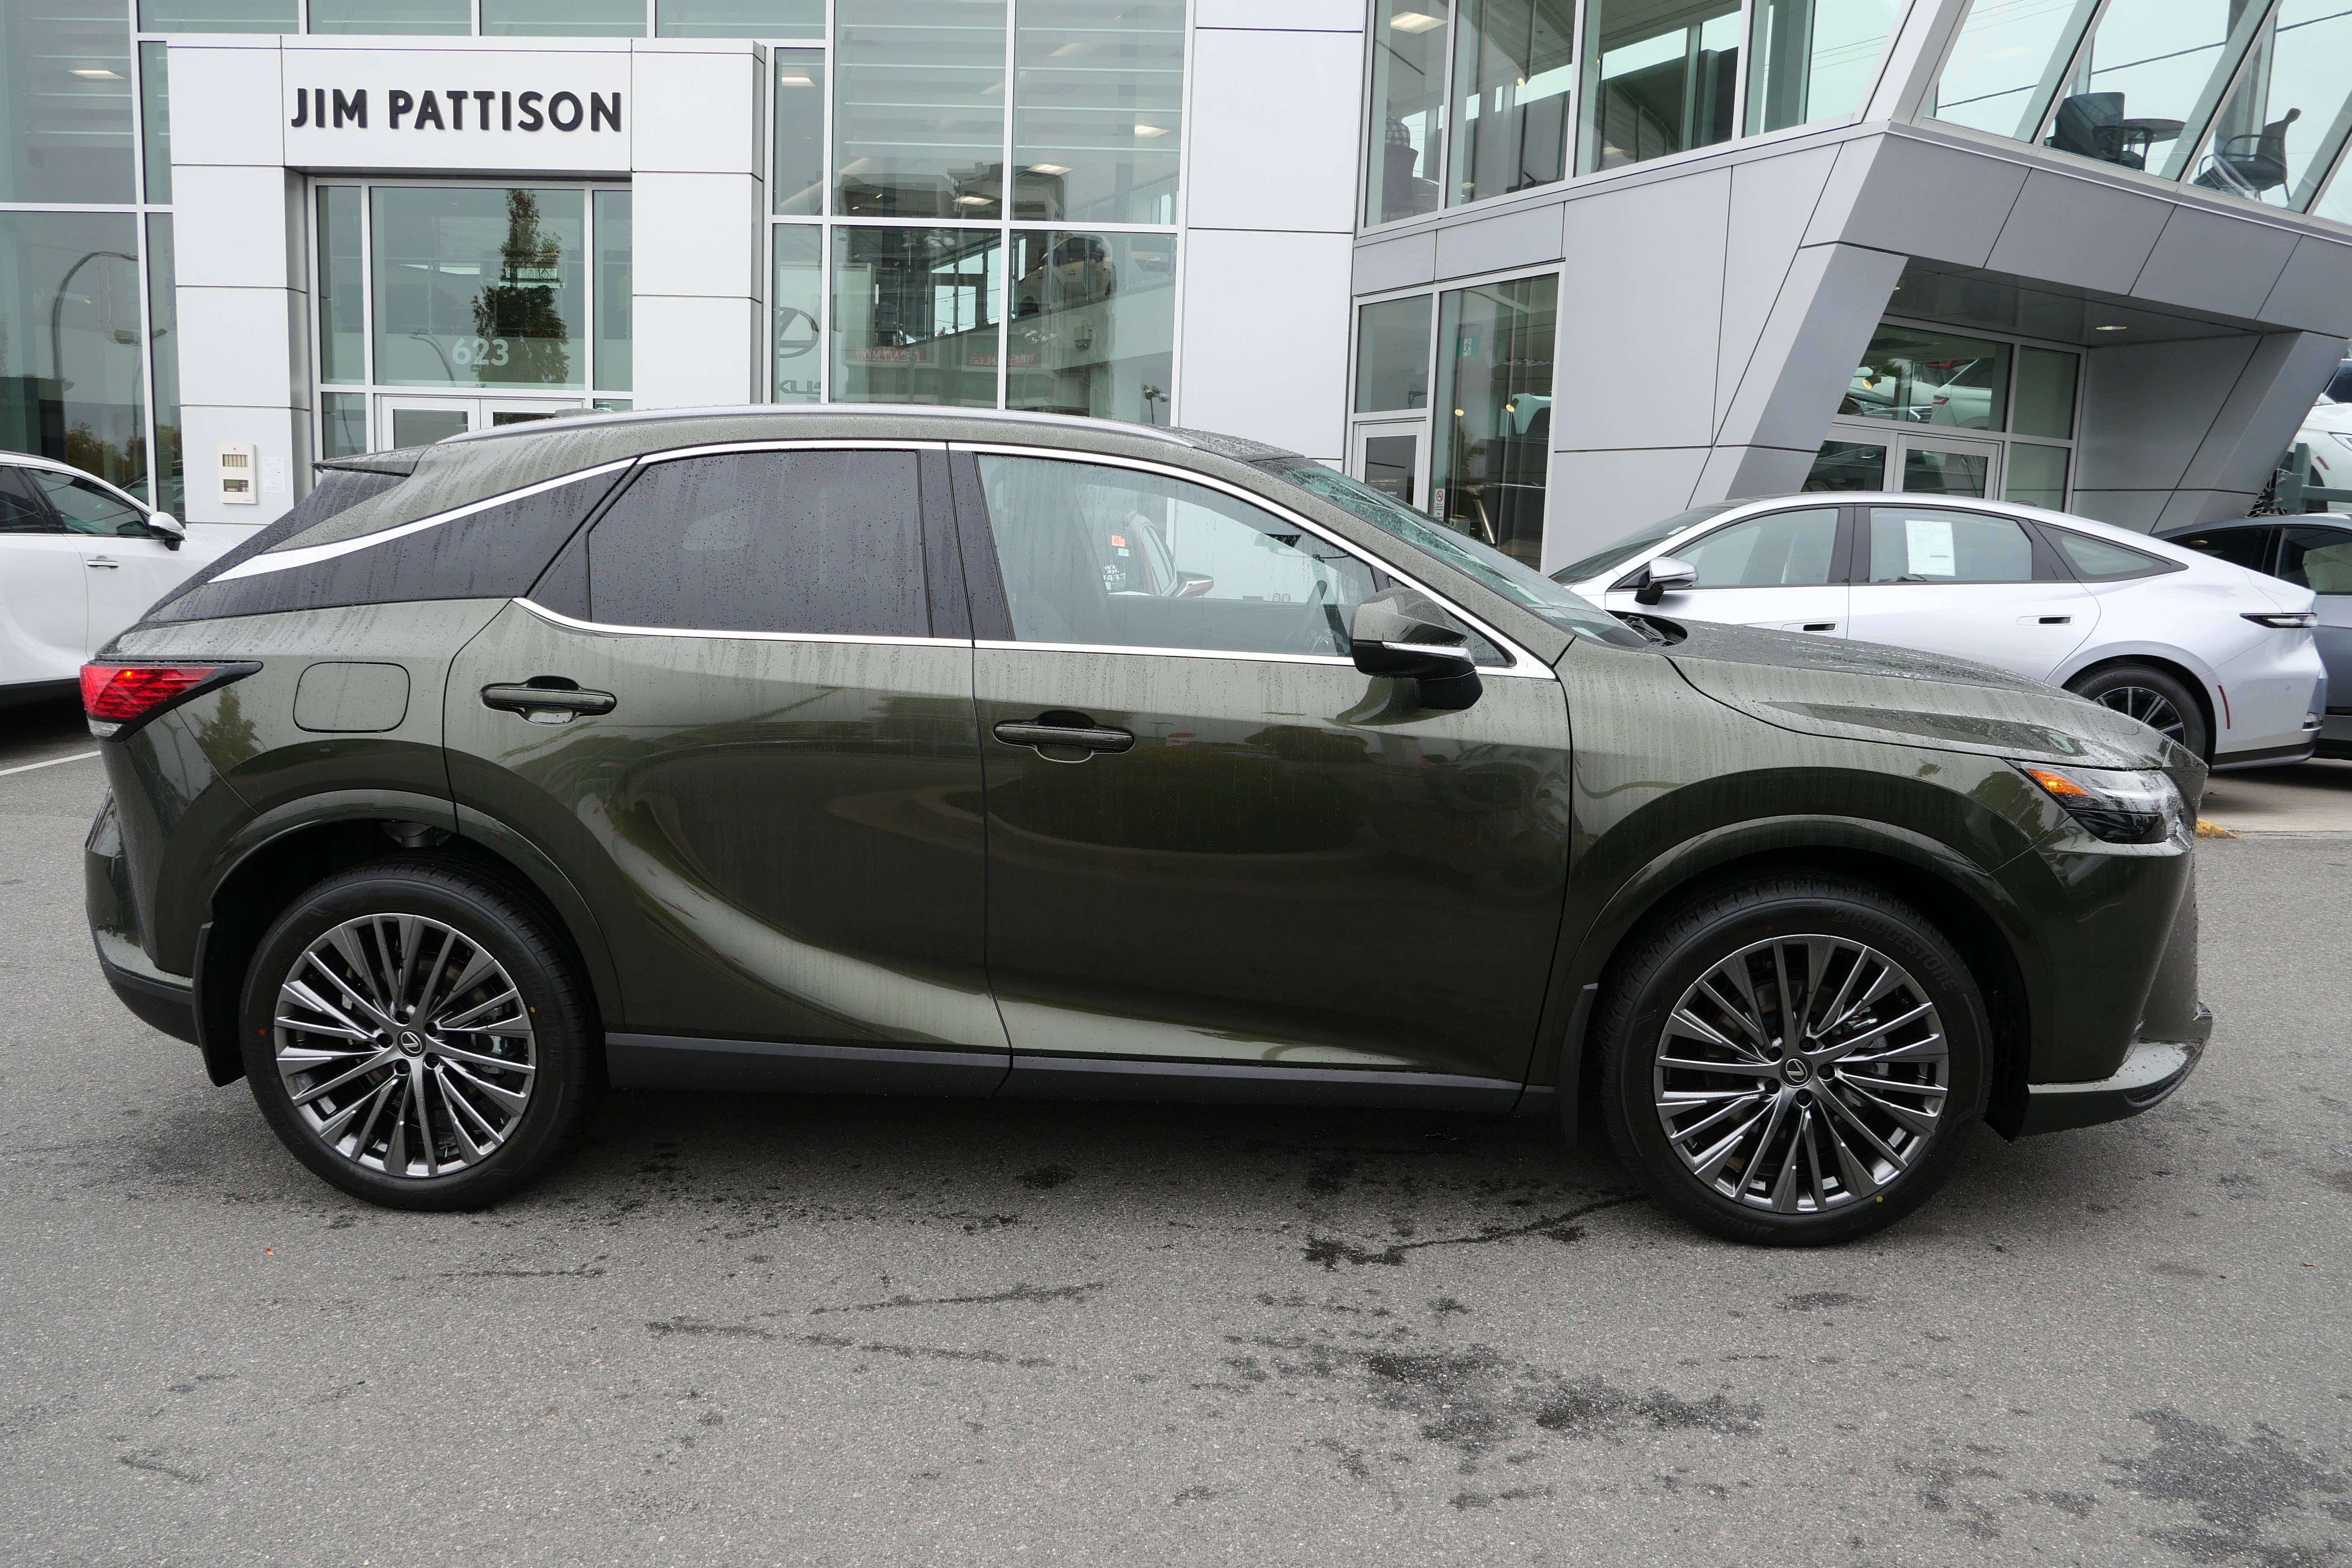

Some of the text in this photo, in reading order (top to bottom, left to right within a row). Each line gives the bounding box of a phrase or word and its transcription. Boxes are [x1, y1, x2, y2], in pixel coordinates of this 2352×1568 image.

[291, 88, 622, 132] JIM PATTISON
[452, 338, 509, 366] 623
[1829, 906, 1958, 991] BRIDGESTONE
